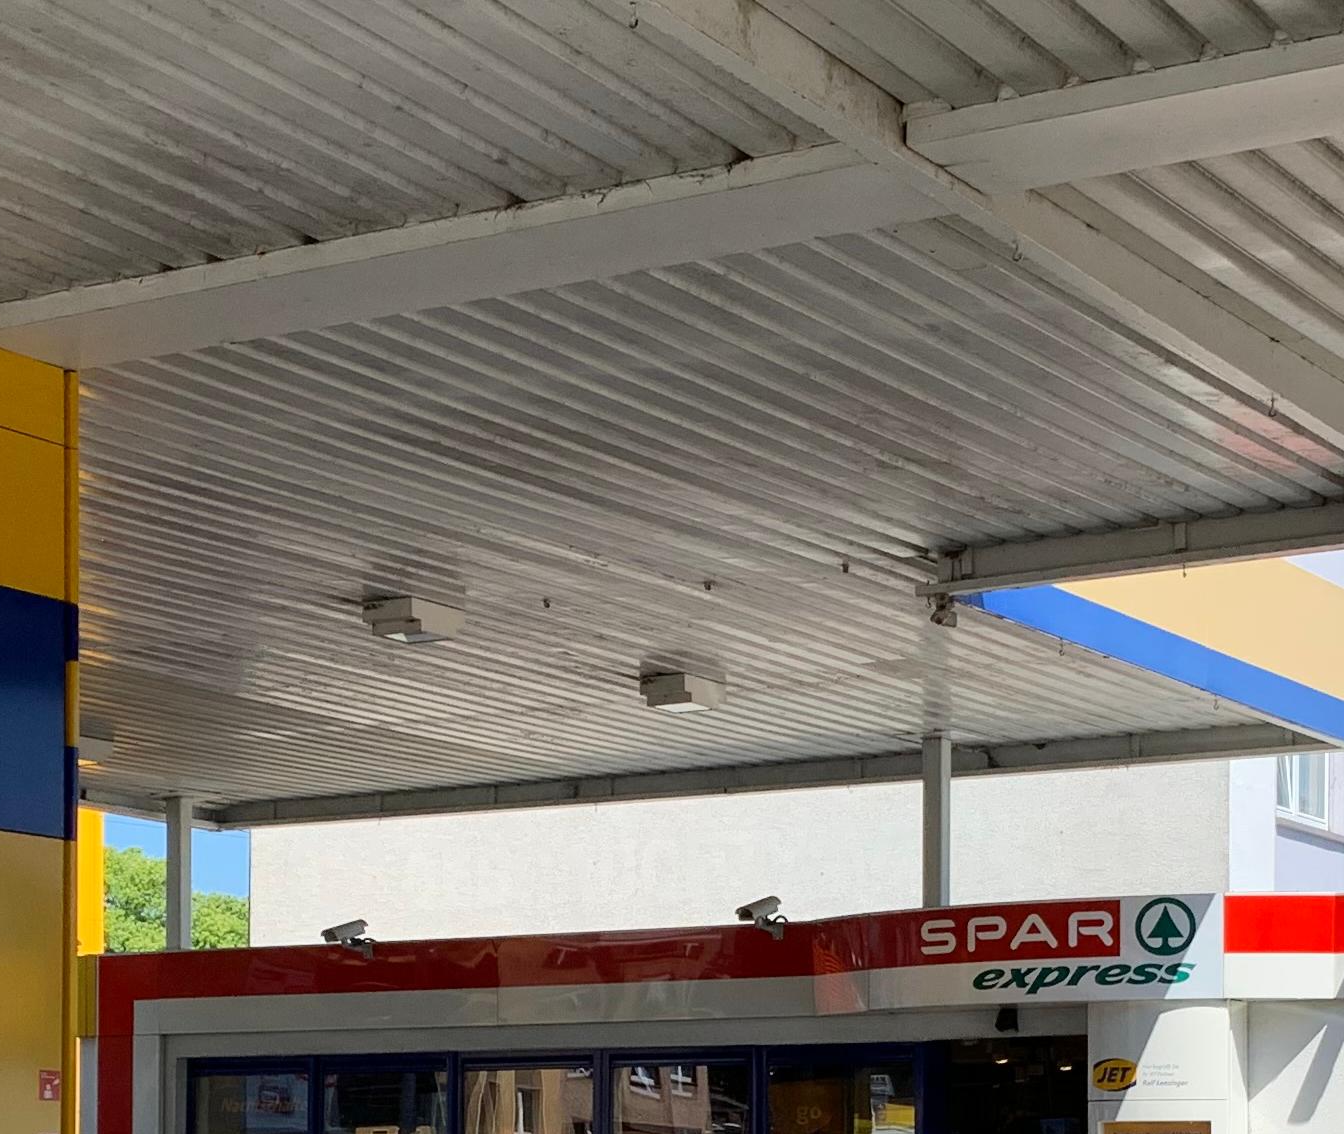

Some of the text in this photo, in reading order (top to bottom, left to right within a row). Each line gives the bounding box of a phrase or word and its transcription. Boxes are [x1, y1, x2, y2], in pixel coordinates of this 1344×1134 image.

[920, 910, 1114, 956] SPAR
[972, 962, 1196, 995] express
[1097, 1067, 1132, 1083] JET
